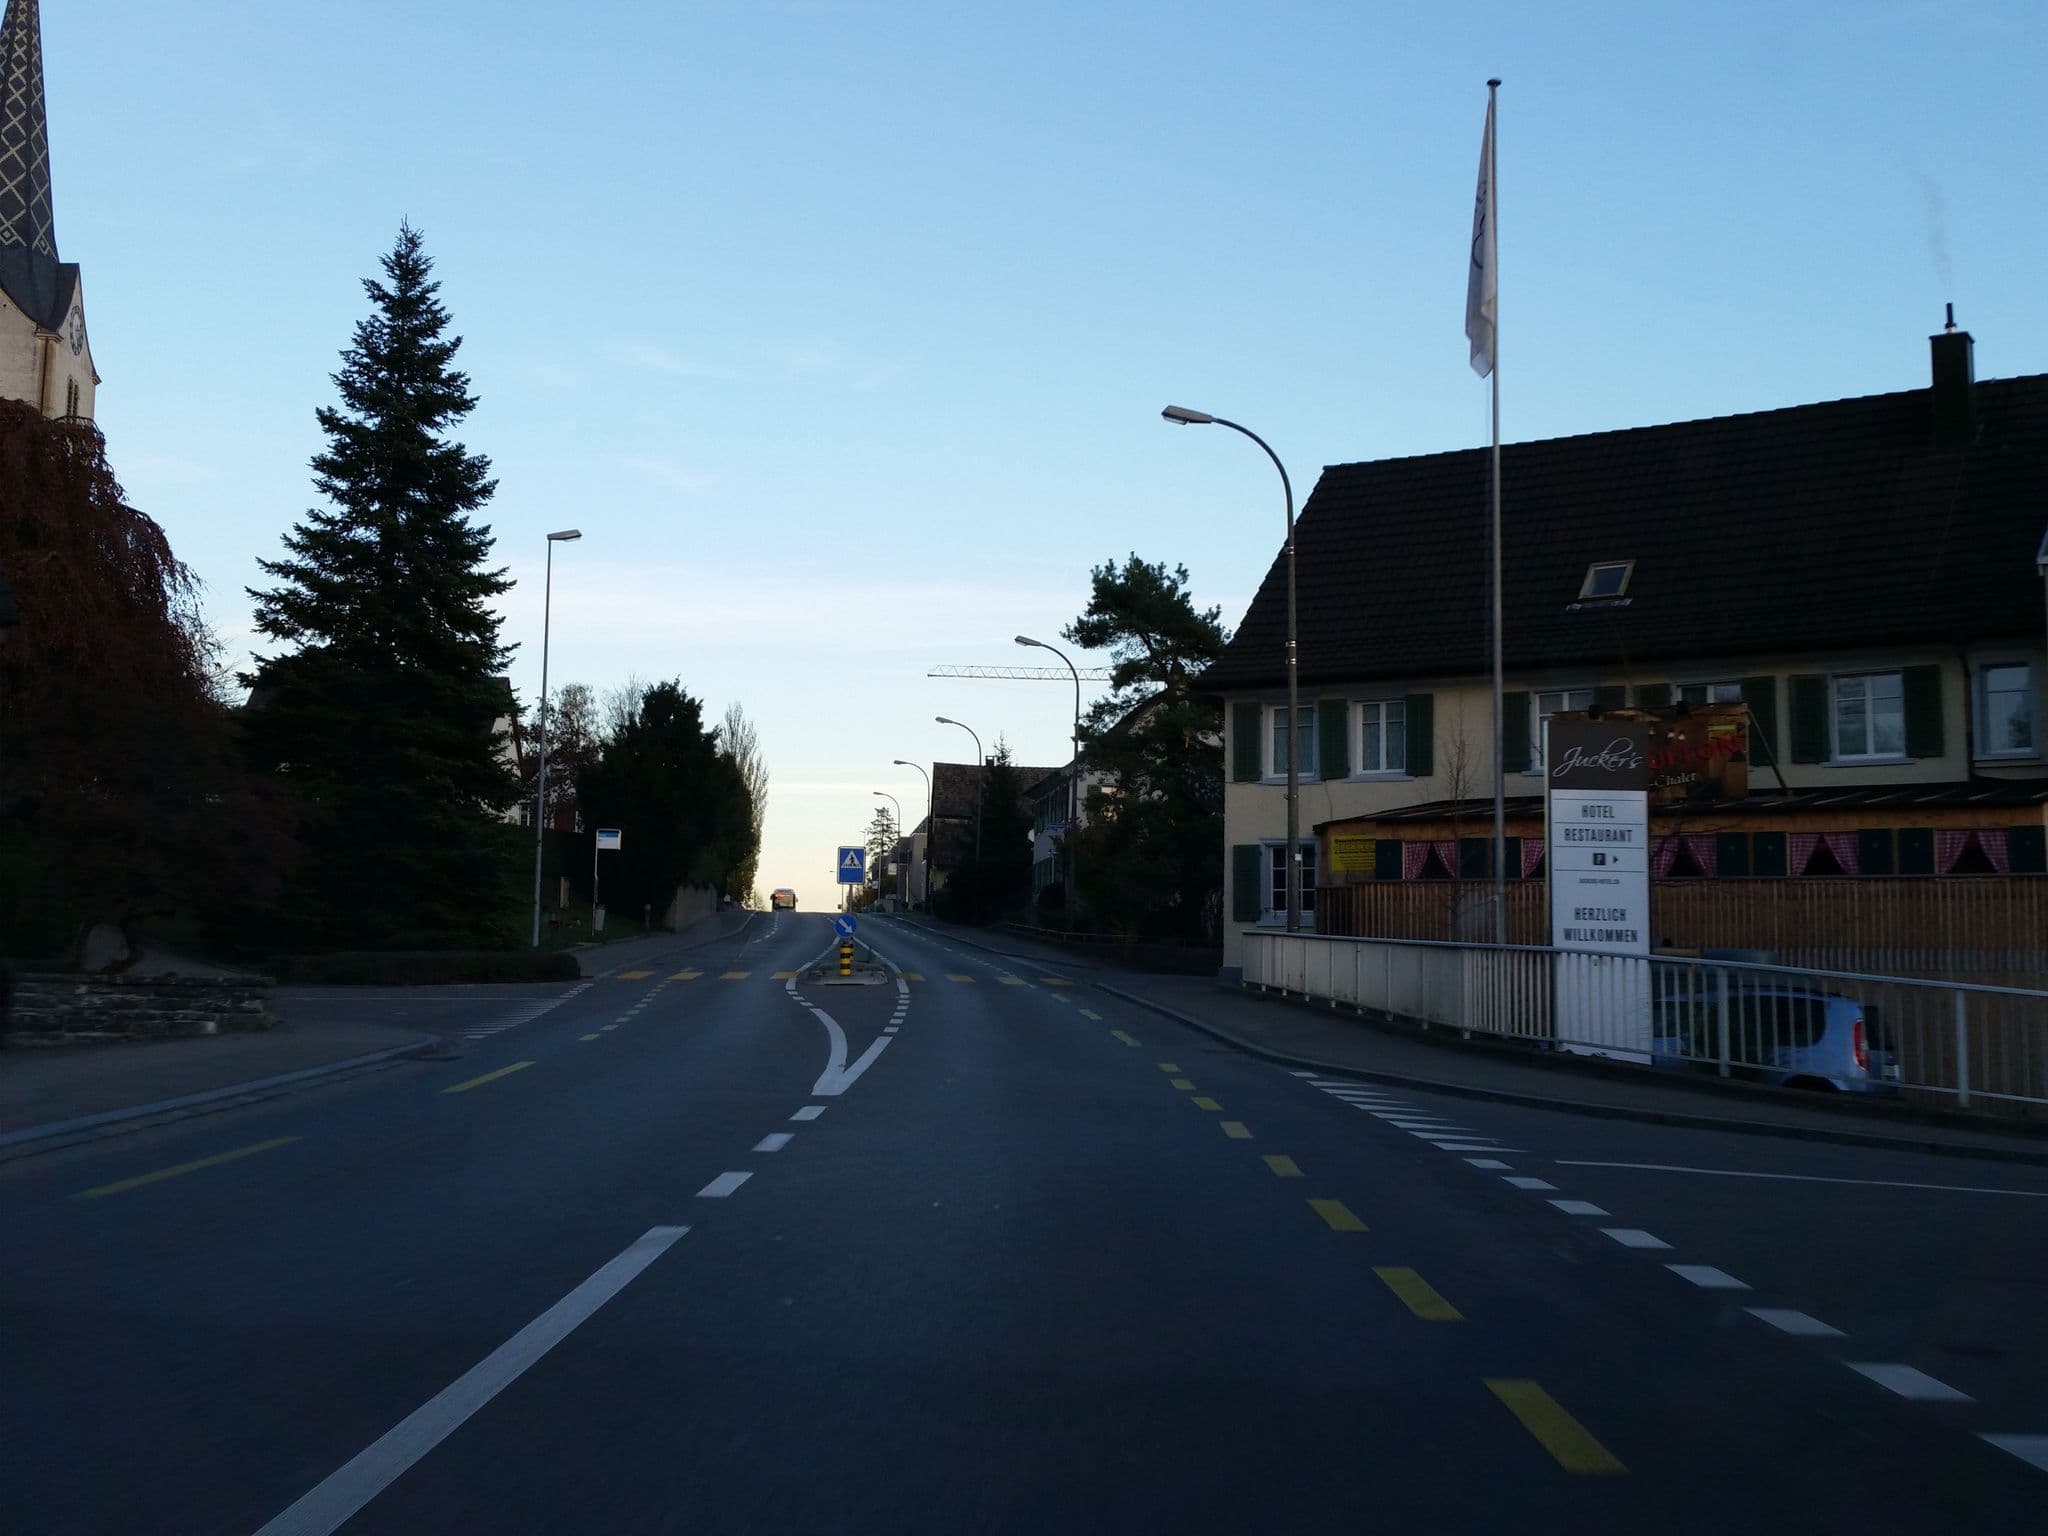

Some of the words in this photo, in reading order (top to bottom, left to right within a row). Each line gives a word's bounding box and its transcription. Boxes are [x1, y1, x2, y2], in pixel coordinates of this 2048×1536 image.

[1553, 737, 1643, 777] Jucker's
[1582, 805, 1615, 818] HOTEL
[1564, 828, 1632, 842] RESTAURANT
[1575, 907, 1626, 921] HERZLICH
[1563, 928, 1638, 942] WILLKOMMEN
